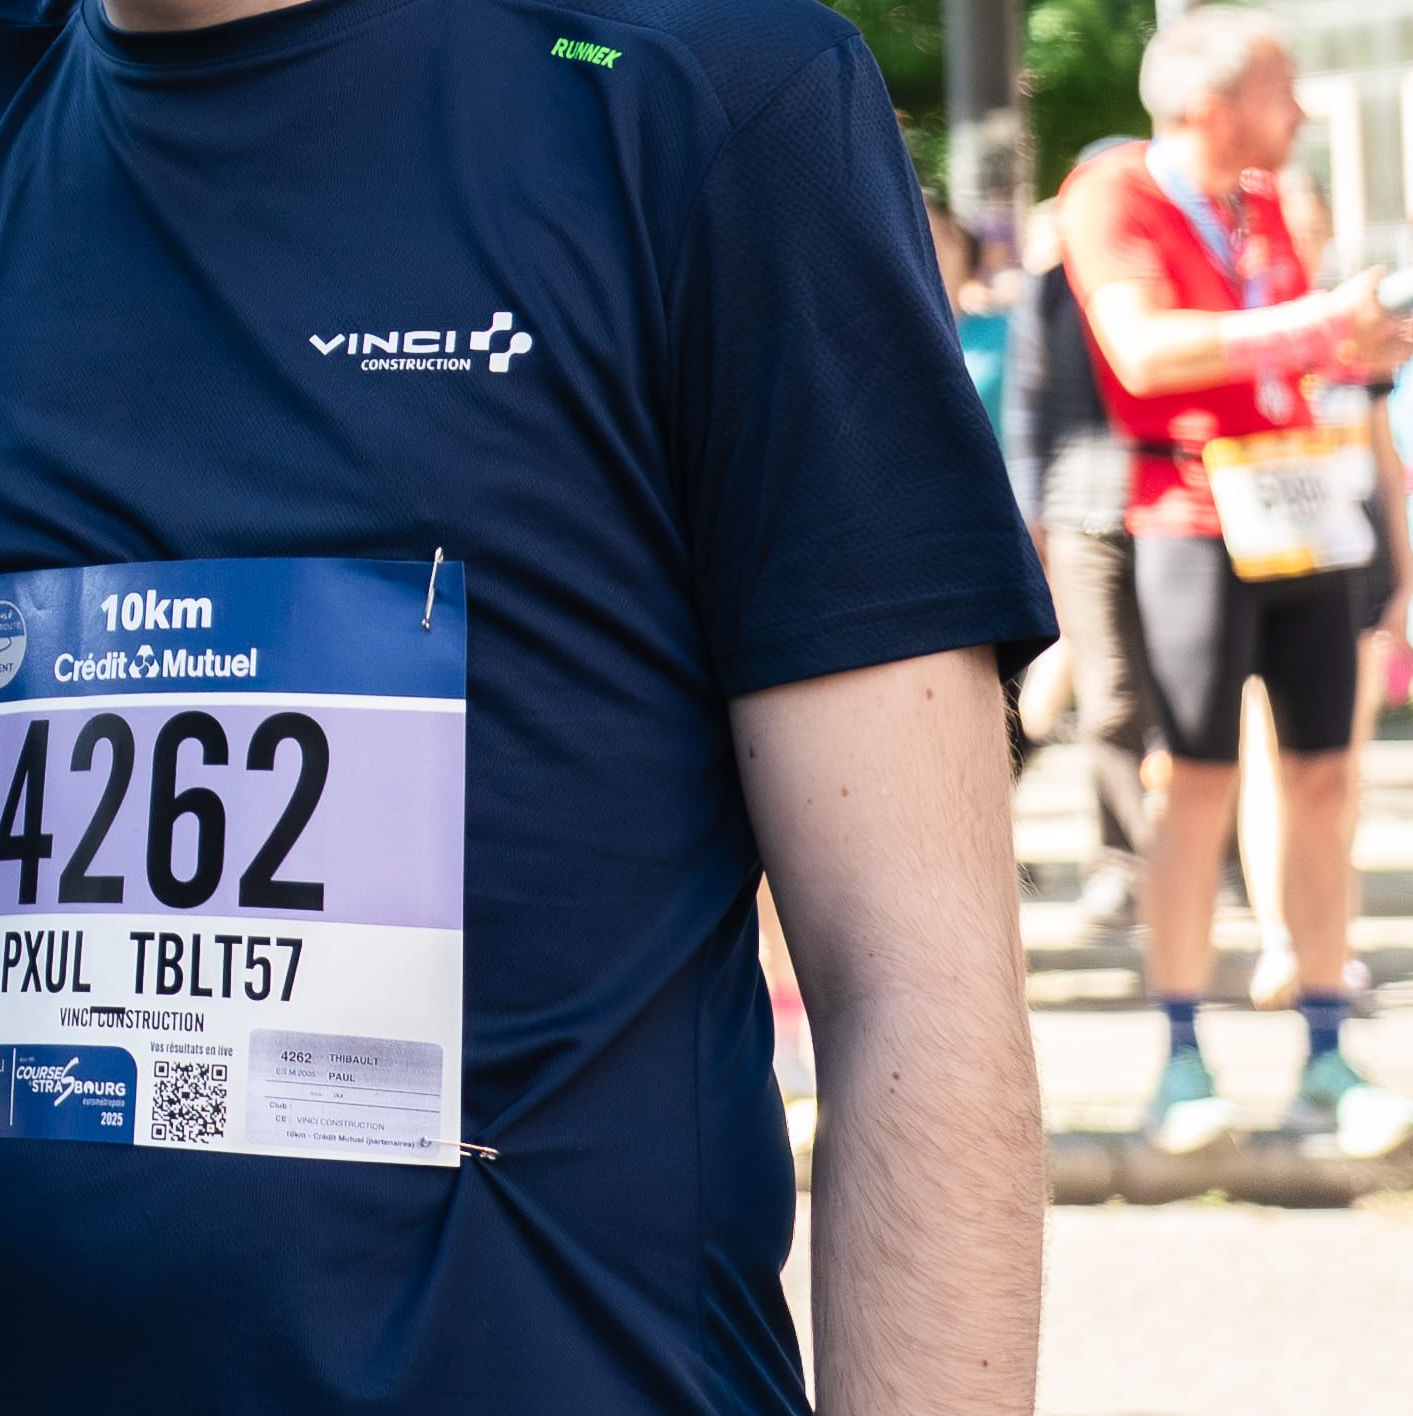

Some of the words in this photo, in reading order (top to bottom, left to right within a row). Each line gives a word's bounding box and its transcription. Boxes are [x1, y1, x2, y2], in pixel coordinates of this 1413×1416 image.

[551, 37, 622, 69] RUNNEK
[309, 330, 457, 355] VINCI
[361, 358, 471, 372] CONSTRUCTION
[101, 590, 212, 632] 10km
[54, 650, 127, 682] Crédit
[162, 648, 257, 678] Mutuel
[1, 931, 91, 993] PXUL
[130, 931, 303, 1002] TBLT57
[60, 1008, 93, 1028] VINCI
[97, 1008, 205, 1032] CONSTRUCTION
[150, 1041, 164, 1053] Vos
[166, 1041, 204, 1055] résultats
[205, 1046, 216, 1056] en
[218, 1046, 233, 1057] live
[281, 1050, 312, 1064] 4262
[330, 1053, 380, 1066] THIBAULT
[328, 1072, 356, 1083] PAUL
[101, 1112, 123, 1126] 2025
[275, 1115, 287, 1123] CE
[296, 1116, 319, 1126] VINCI
[320, 1118, 385, 1131] CONSTRUCTION
[338, 1134, 364, 1144] Mutuel
